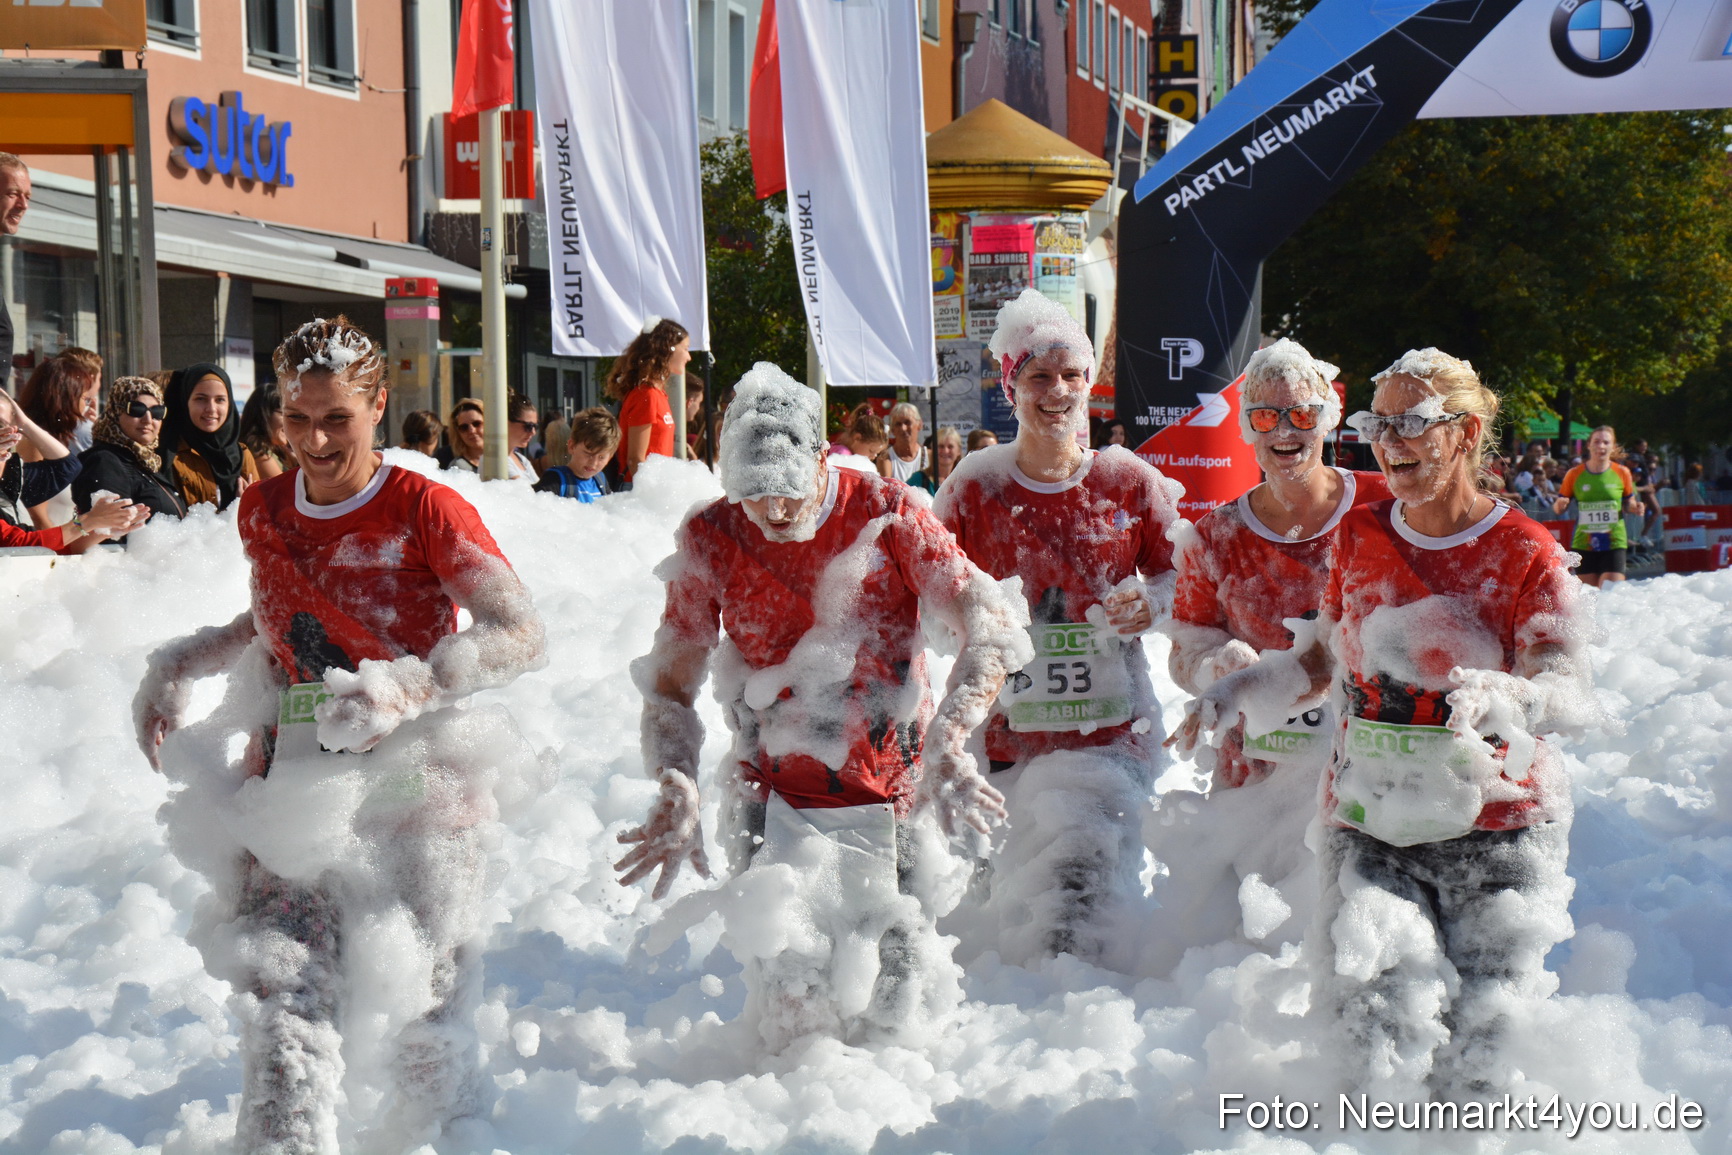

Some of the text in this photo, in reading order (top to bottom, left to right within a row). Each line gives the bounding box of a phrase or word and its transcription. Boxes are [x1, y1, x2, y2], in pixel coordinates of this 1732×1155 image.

[1164, 64, 1378, 216] PARTL NEUMARKT
[970, 252, 1029, 265] BAND SUNRISE
[1148, 406, 1192, 417] THE NEXT
[1135, 416, 1181, 426] 100 YEARS
[1169, 454, 1232, 469] Laufsport
[1588, 512, 1610, 522] 118
[1047, 661, 1092, 694] 53
